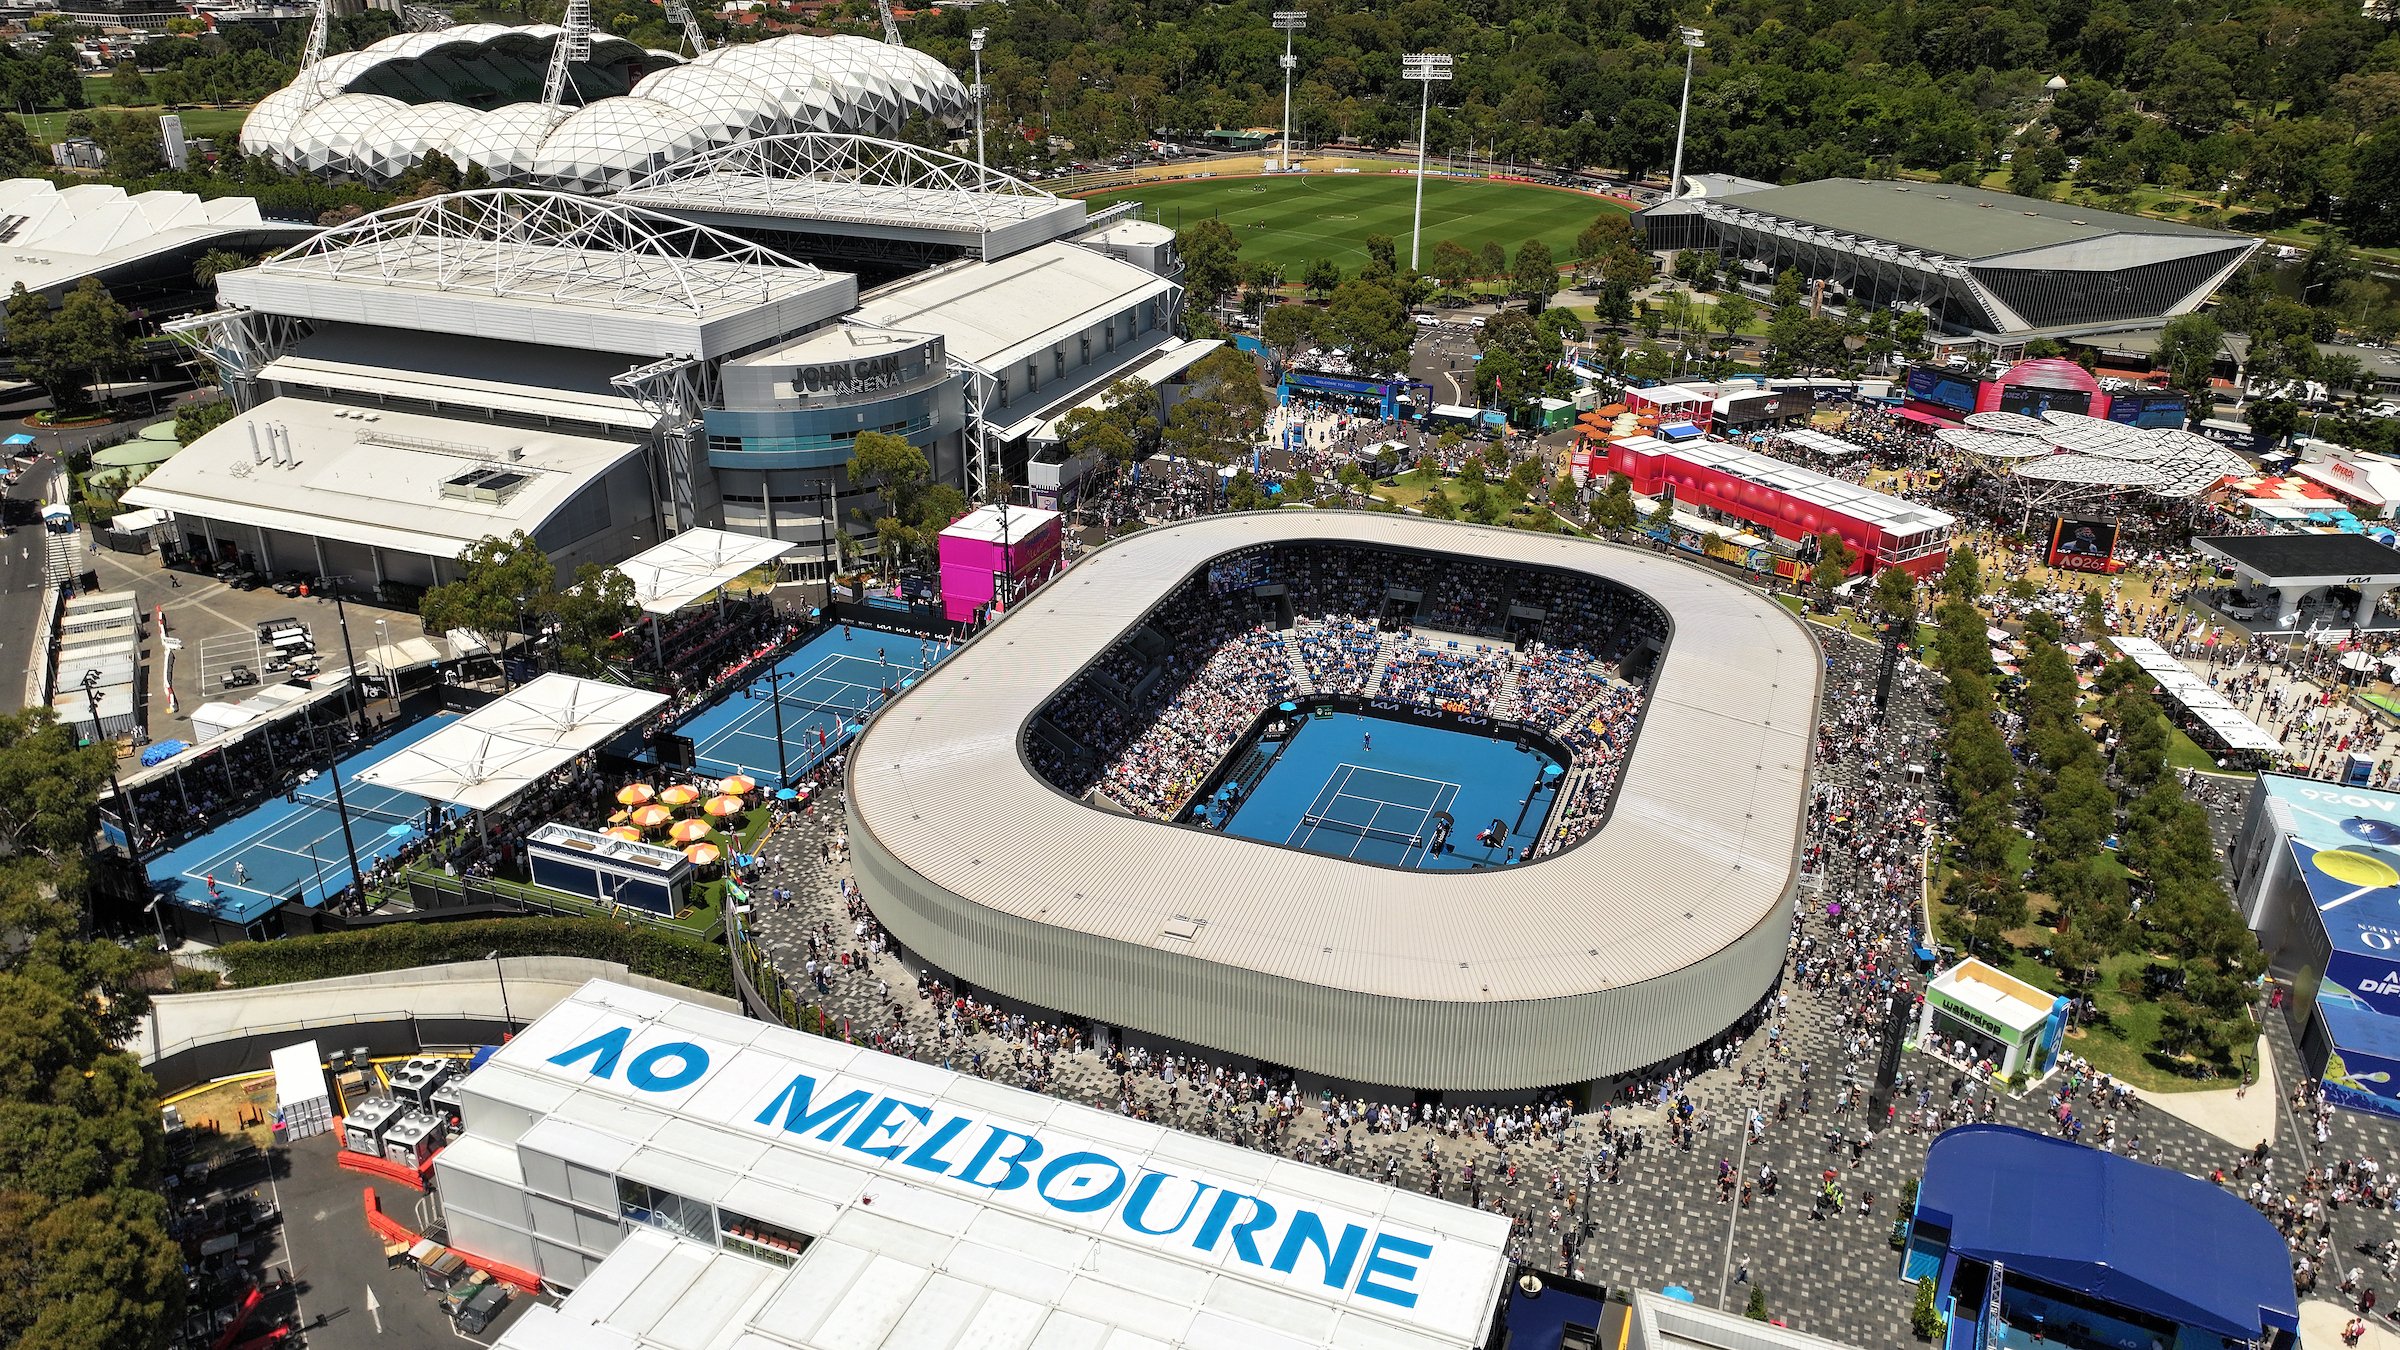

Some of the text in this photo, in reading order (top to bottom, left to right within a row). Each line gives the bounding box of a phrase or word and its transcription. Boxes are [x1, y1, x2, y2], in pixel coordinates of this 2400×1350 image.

[791, 355, 899, 383] JOHN CAIN
[835, 371, 901, 397] ARENA
[2331, 463, 2356, 479] APEROL
[2060, 555, 2099, 569] AO26
[1882, 635, 1897, 676] Kia Arena
[1370, 700, 1487, 726] KIA KIA KIA
[1498, 722, 1520, 730] Emirates
[2300, 788, 2397, 812] AO26
[1942, 999, 2002, 1036] waterdrop
[2051, 1028, 2062, 1052] AO
[549, 1027, 1432, 1308] AO MELBOURNE
[2119, 1339, 2137, 1349] AO
